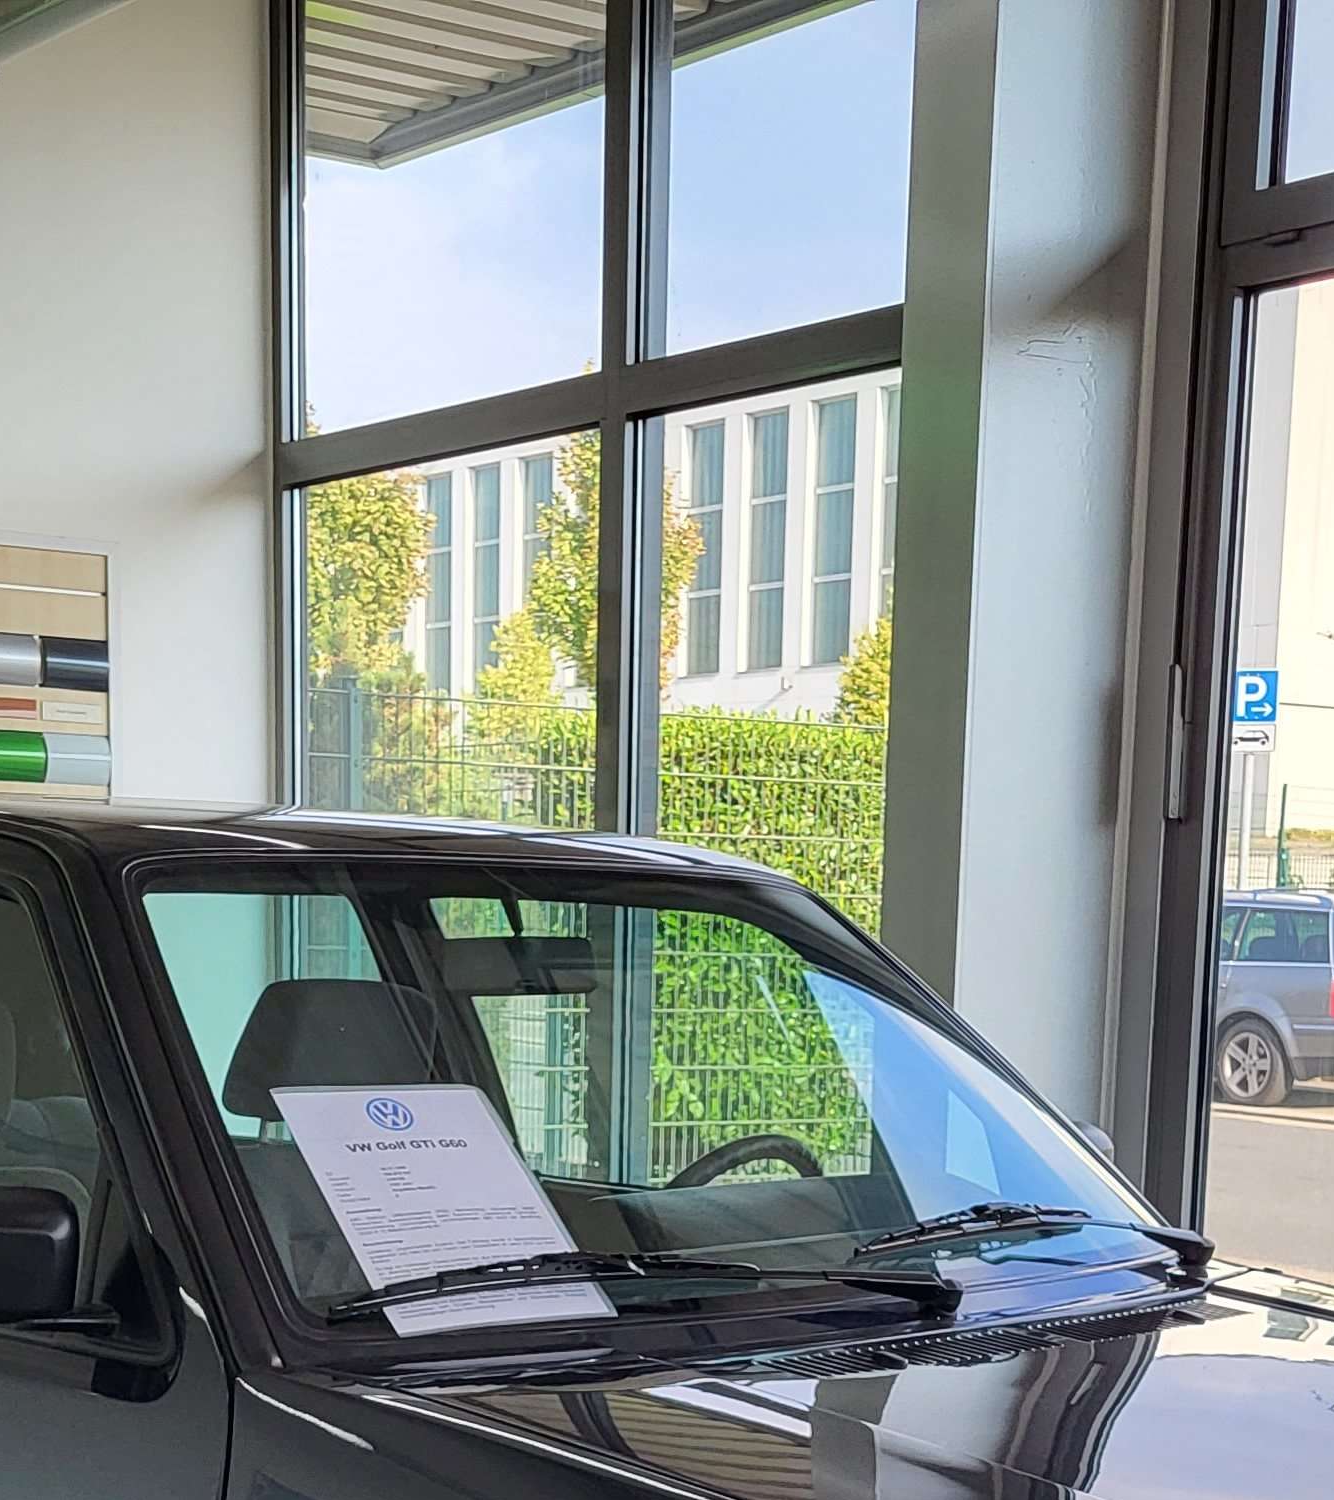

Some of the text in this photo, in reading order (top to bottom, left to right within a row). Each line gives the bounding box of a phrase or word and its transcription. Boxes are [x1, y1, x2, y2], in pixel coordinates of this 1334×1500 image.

[1236, 675, 1267, 717] P
[345, 1142, 373, 1154] VW
[376, 1140, 407, 1151] Golf
[438, 1138, 468, 1148] G60
